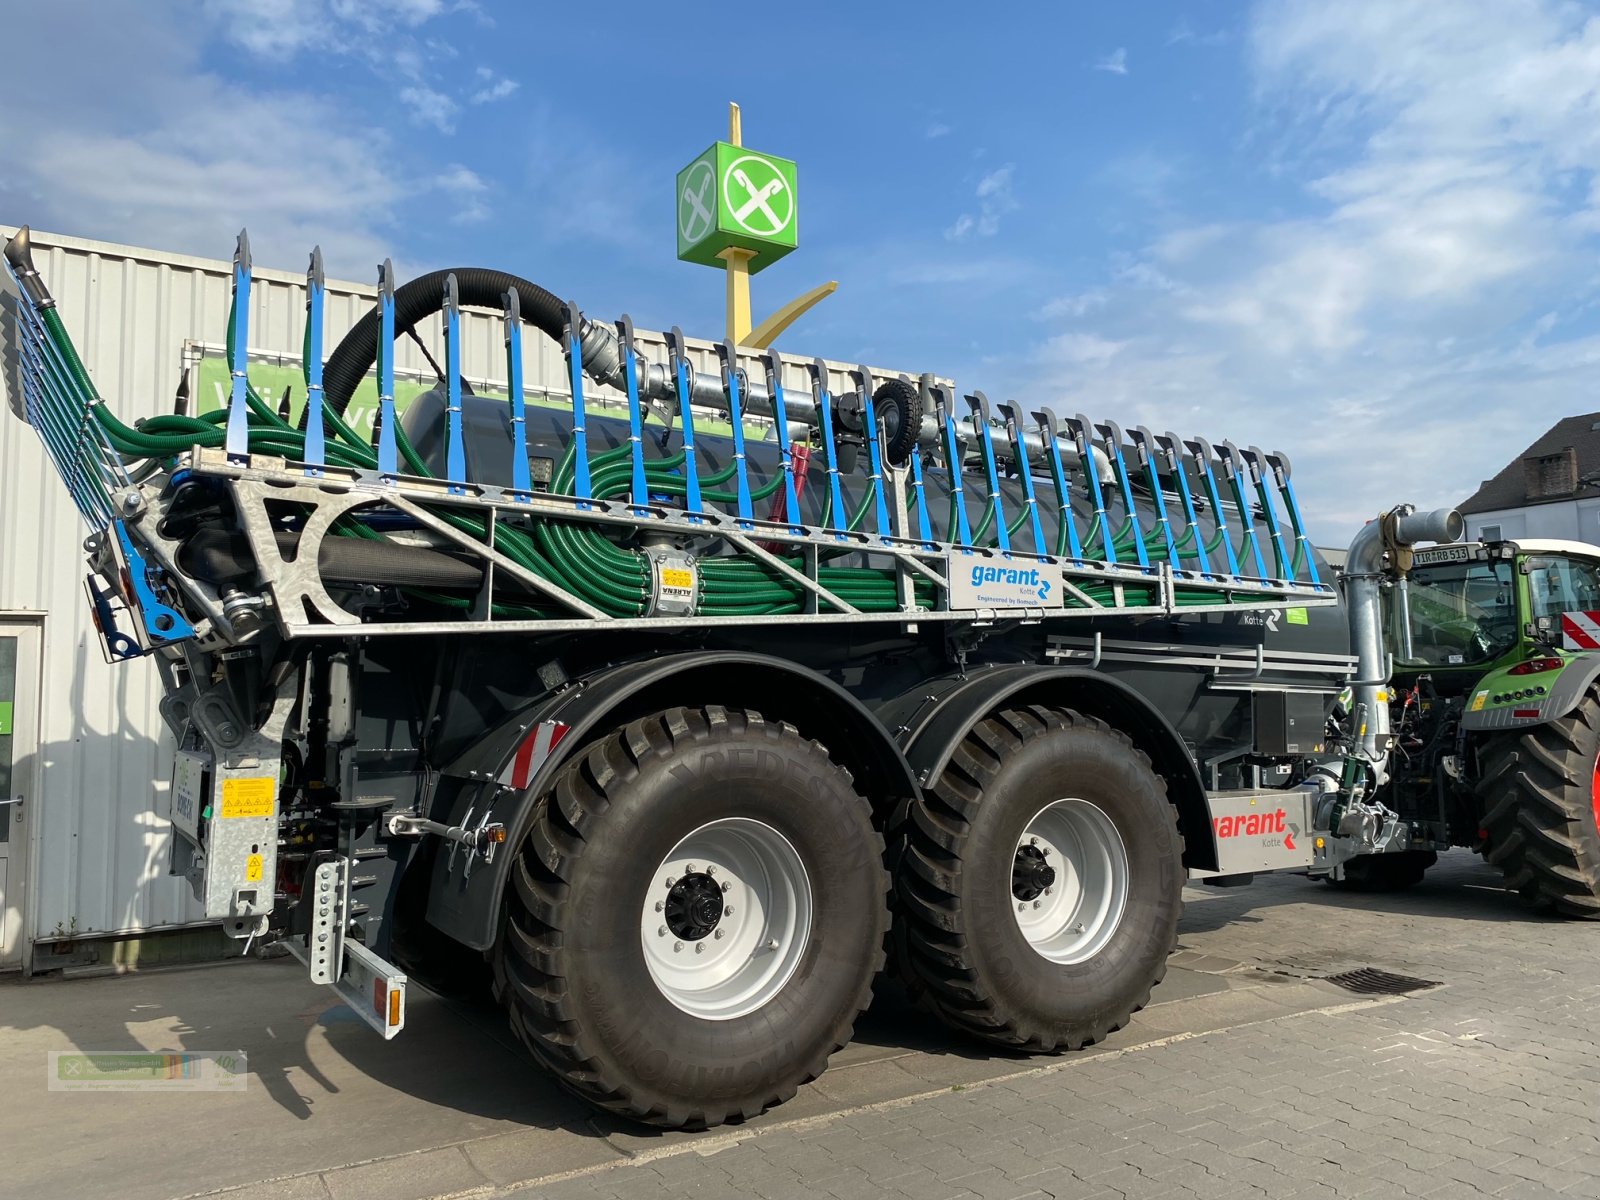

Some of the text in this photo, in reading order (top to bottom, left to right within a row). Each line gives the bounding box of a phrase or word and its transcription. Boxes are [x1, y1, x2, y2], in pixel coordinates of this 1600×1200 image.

[1415, 548, 1467, 563] TIR RB 513
[971, 565, 1039, 587] garant
[662, 587, 692, 597] ALRENA
[1244, 615, 1264, 626] Kotte
[1213, 808, 1287, 838] arant
[1262, 838, 1281, 848] Kotte
